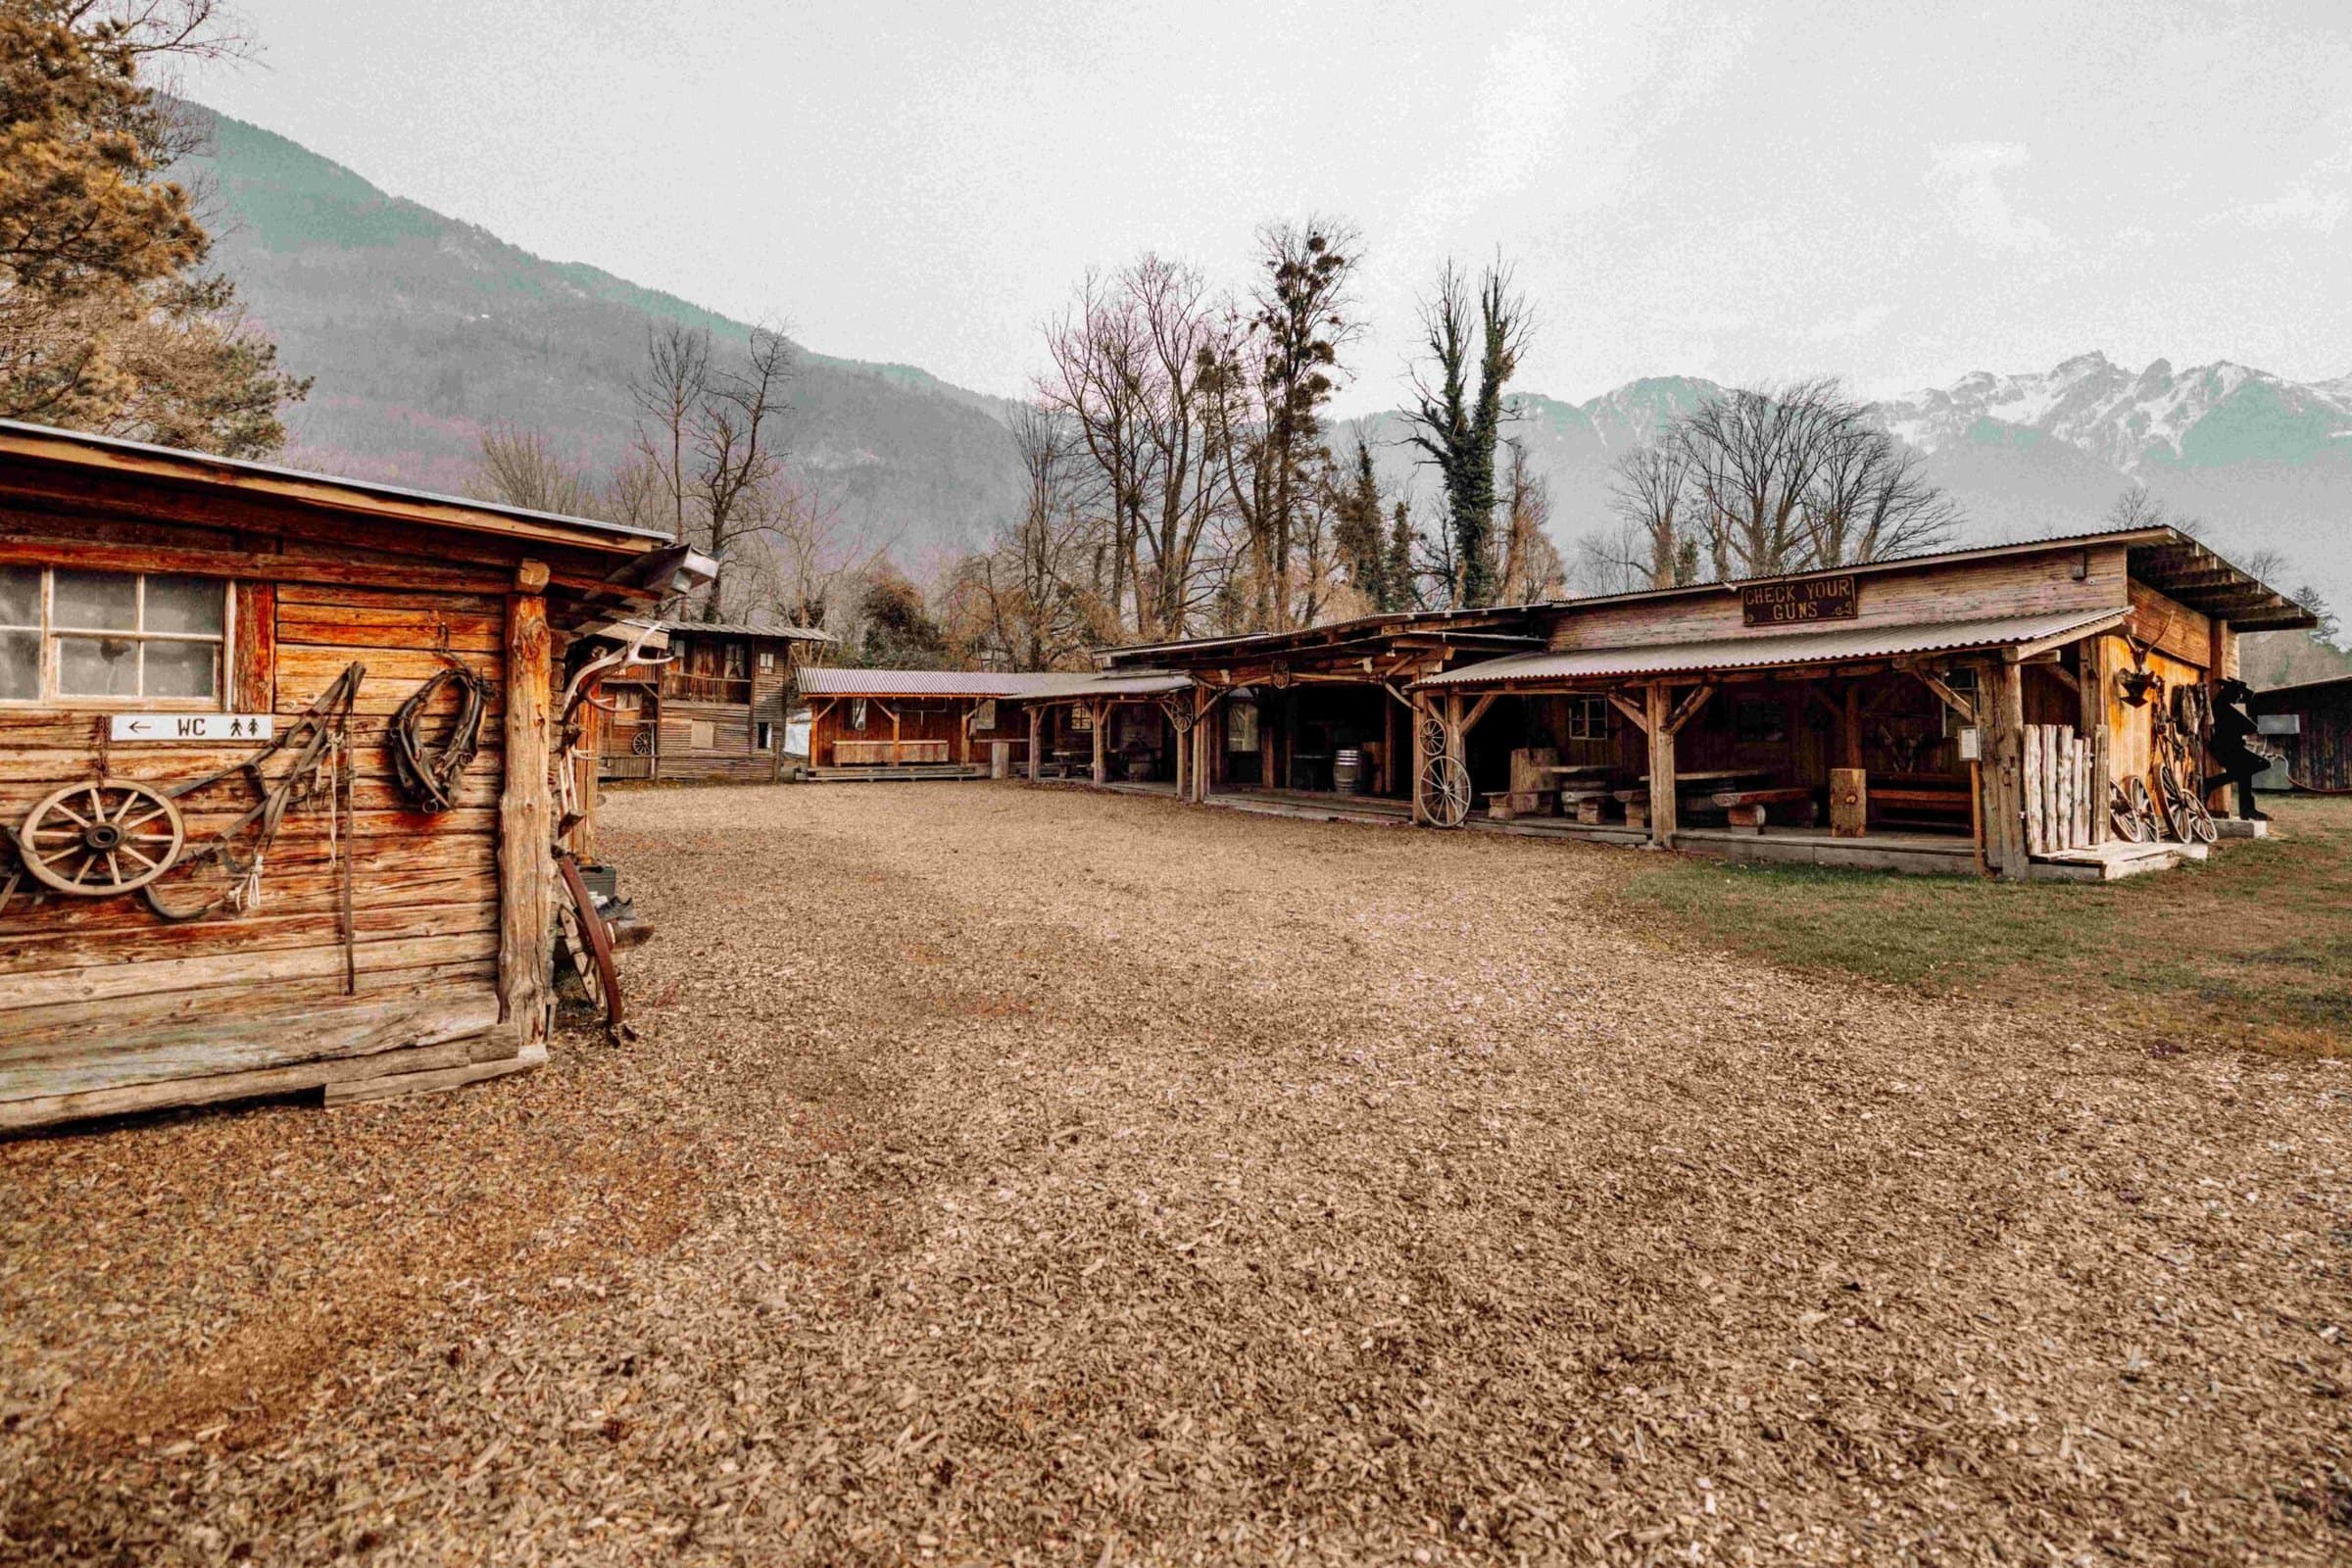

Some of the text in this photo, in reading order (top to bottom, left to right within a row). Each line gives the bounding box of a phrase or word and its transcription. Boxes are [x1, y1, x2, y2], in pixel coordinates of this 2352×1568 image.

[1745, 579, 1850, 605] CHECK YOUR
[1773, 602, 1818, 620] GUNS
[177, 718, 206, 737] WC
